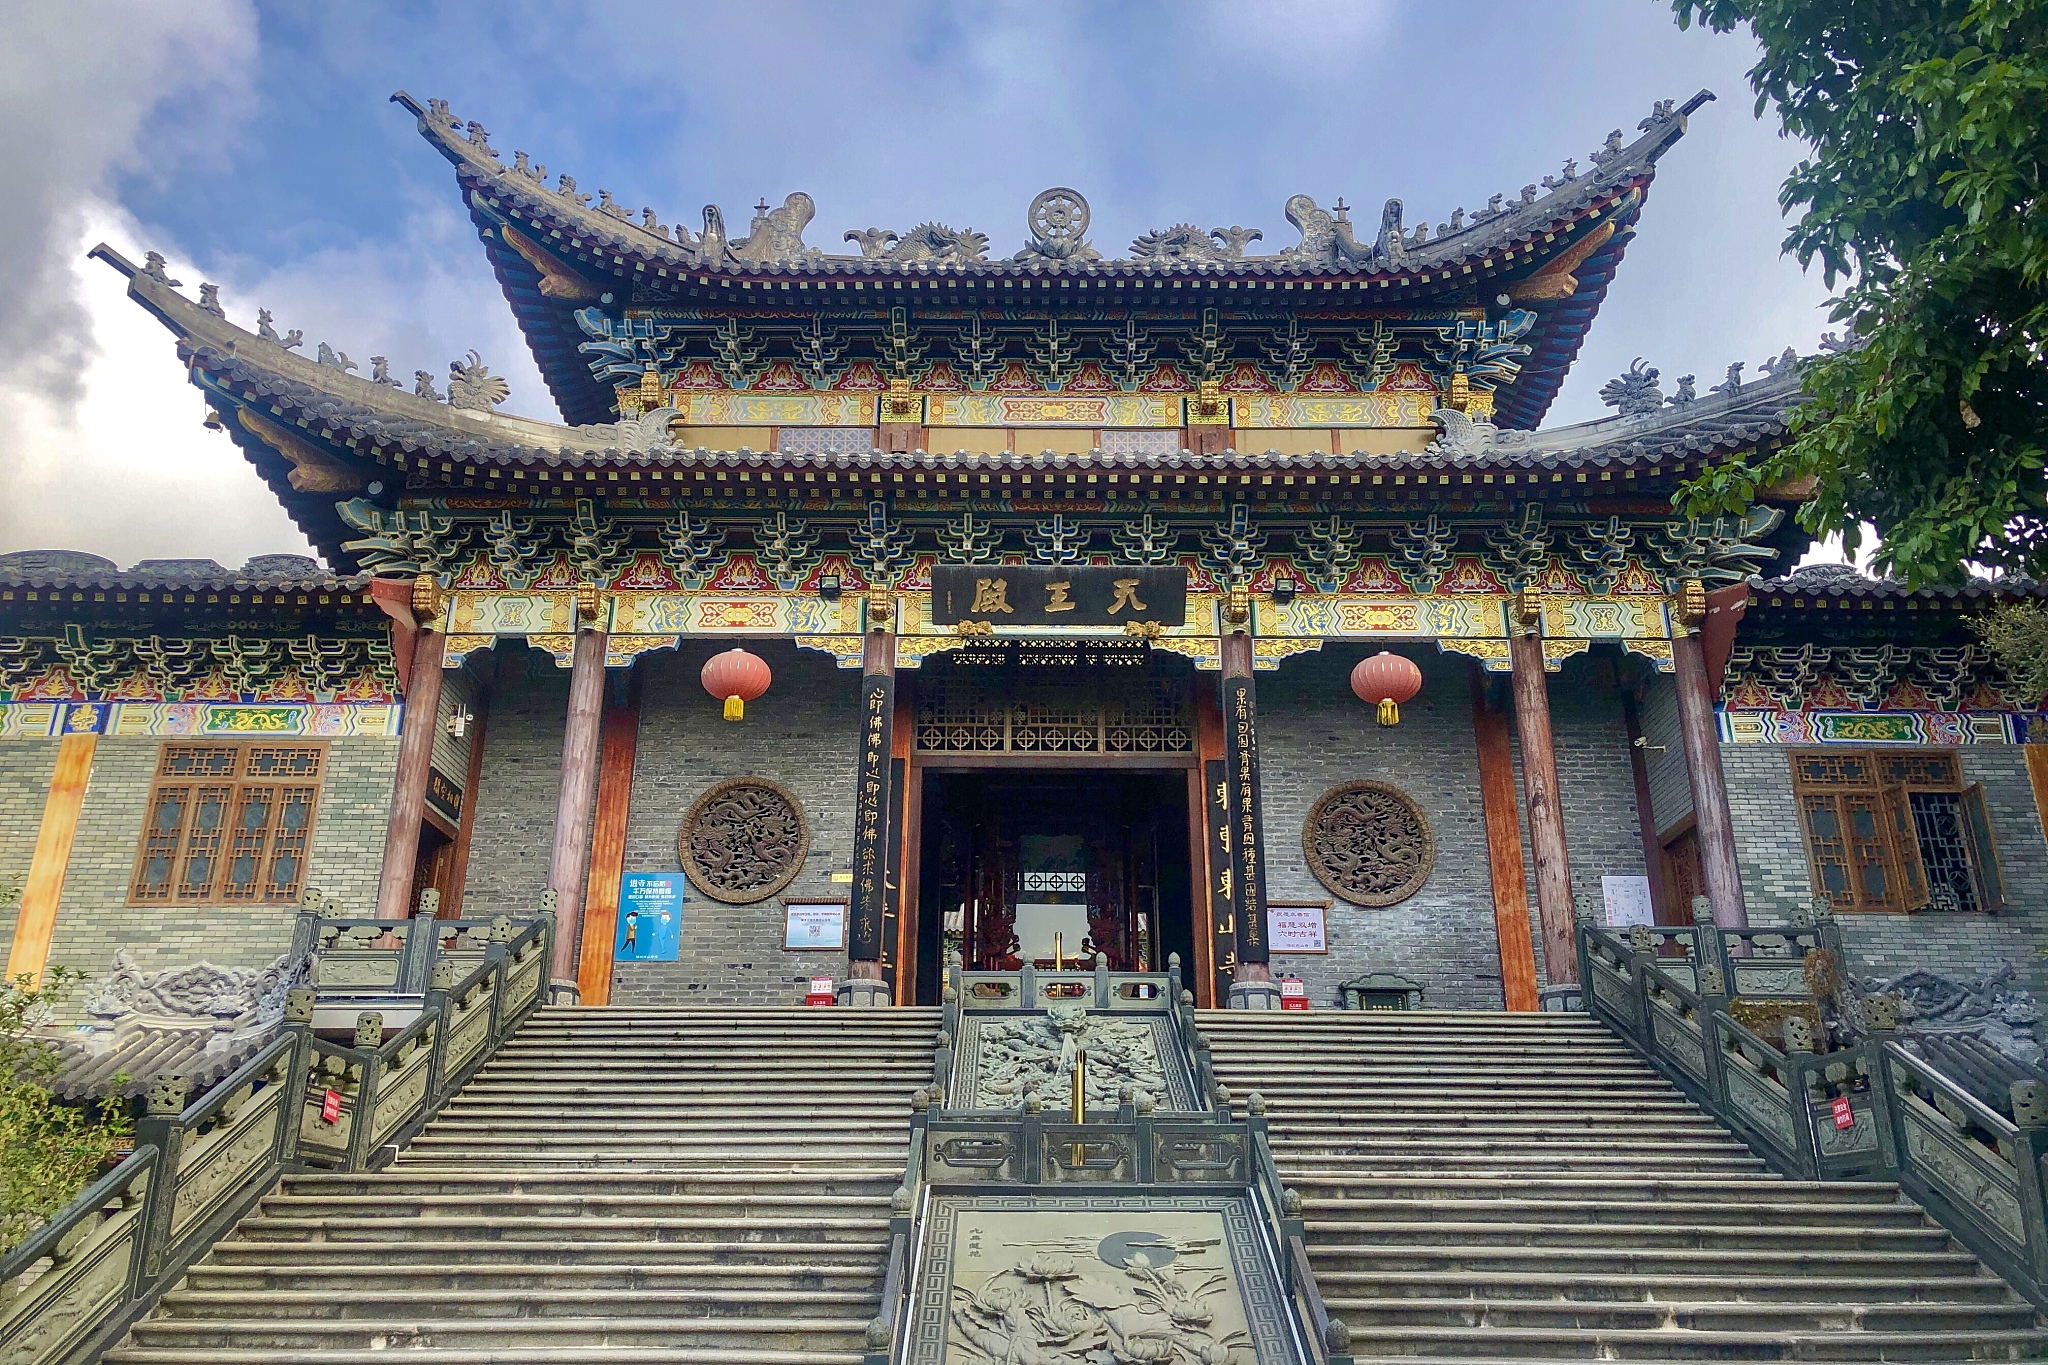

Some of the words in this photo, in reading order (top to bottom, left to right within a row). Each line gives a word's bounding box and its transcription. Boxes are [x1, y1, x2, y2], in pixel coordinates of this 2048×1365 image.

[970, 577, 1148, 615] 天王殿
[1277, 930, 1318, 938] 六时吉祥
